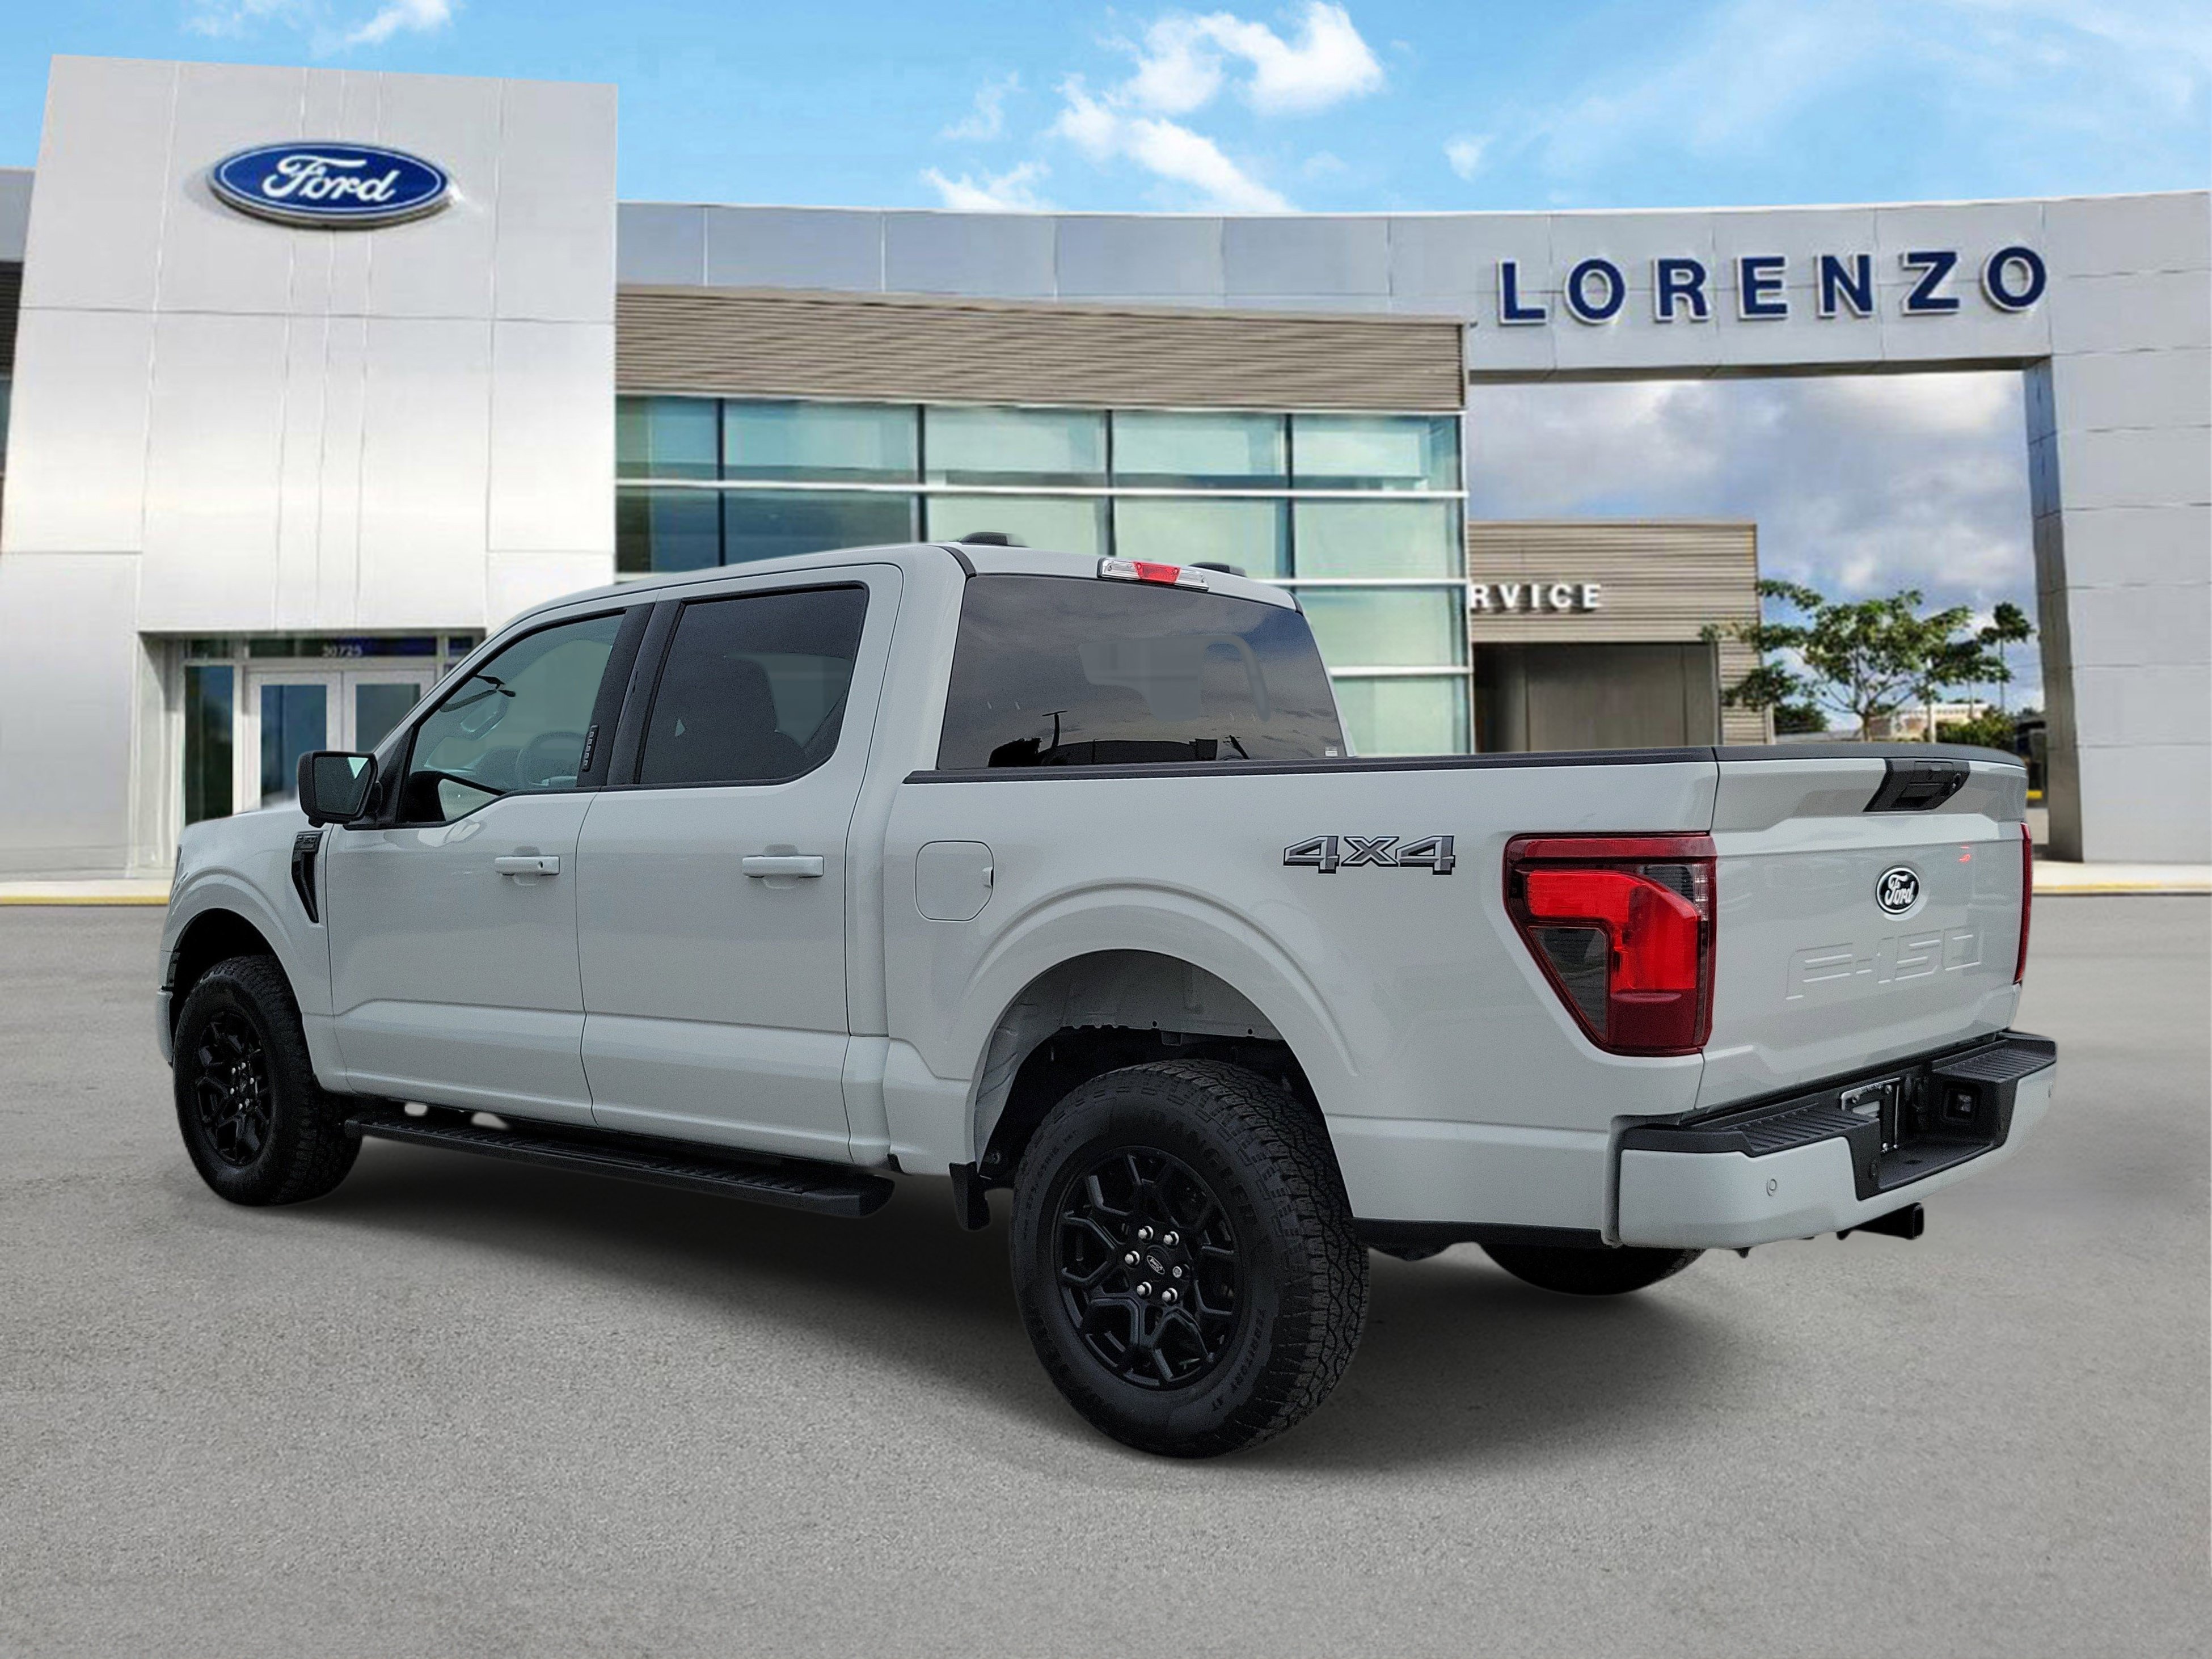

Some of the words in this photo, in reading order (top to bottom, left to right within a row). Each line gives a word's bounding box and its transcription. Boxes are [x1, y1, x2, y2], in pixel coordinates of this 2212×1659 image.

[262, 154, 399, 201] Ford
[1497, 245, 2047, 324] LORENZO
[1884, 873, 1916, 905] Ford
[1785, 925, 1984, 1000] F-150
[1122, 1106, 1259, 1225] RANGLER
